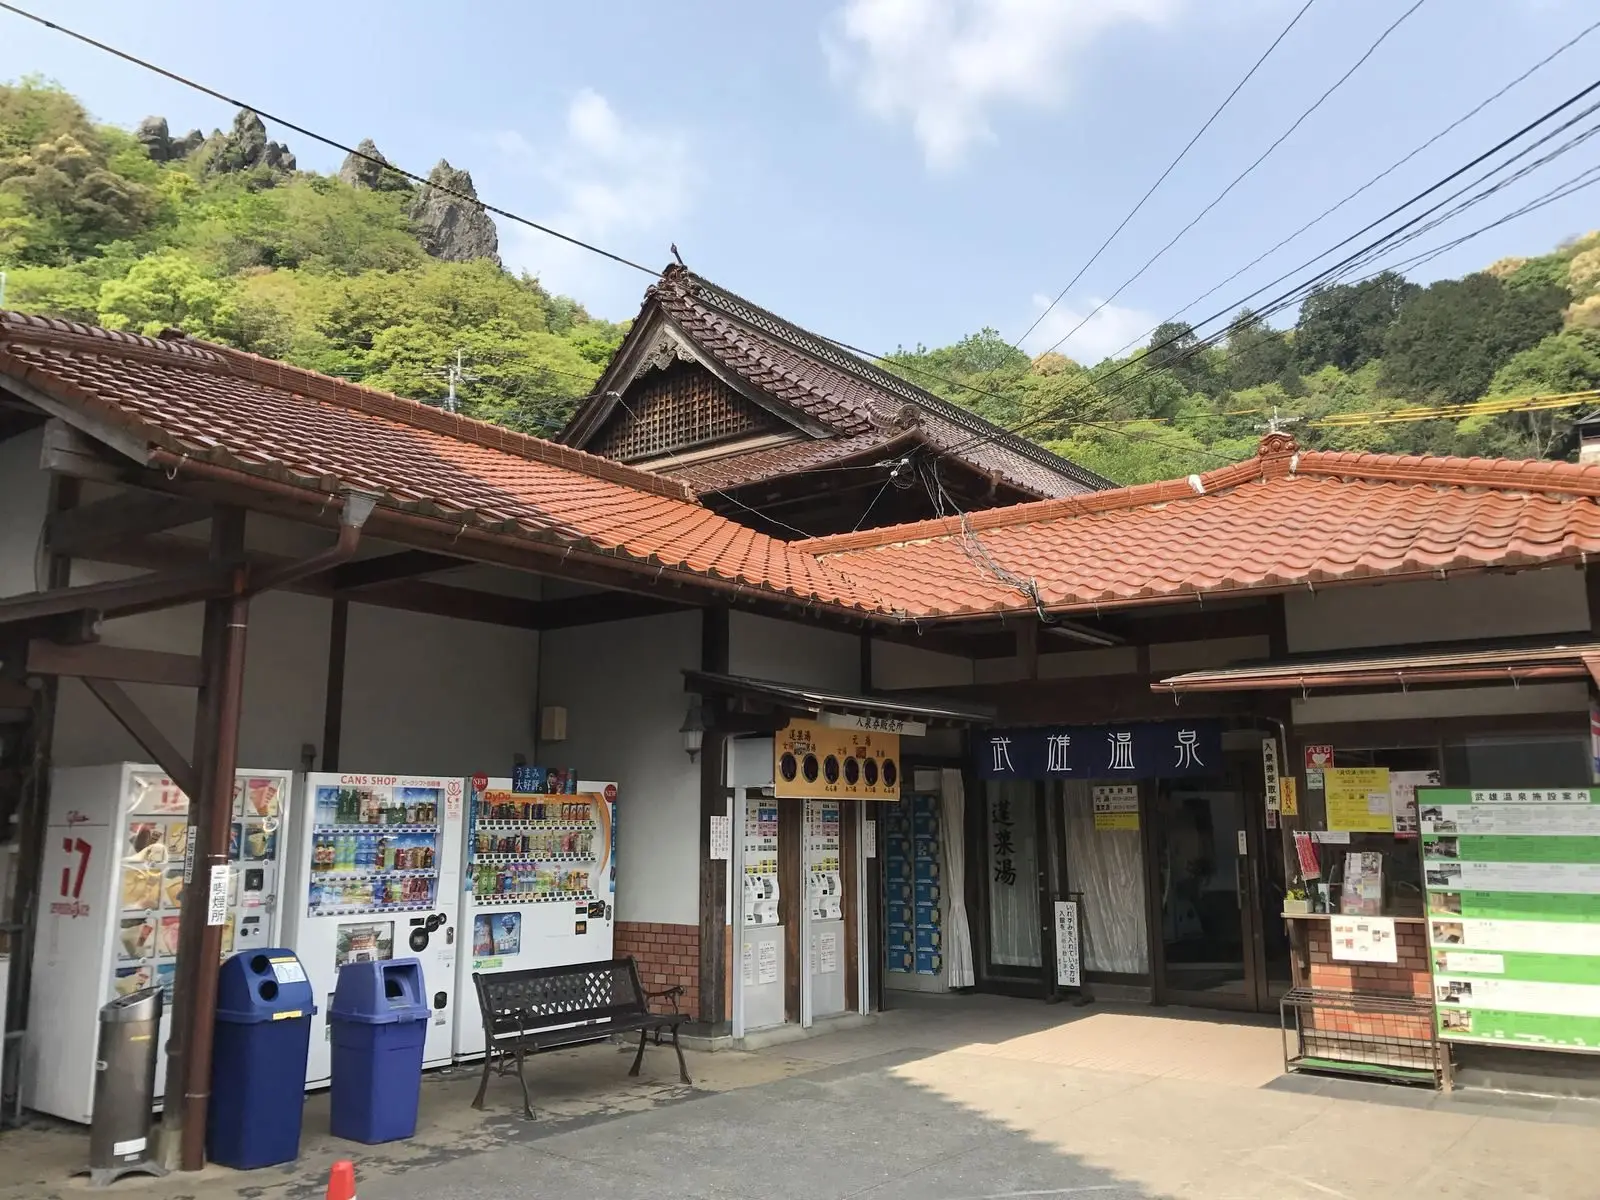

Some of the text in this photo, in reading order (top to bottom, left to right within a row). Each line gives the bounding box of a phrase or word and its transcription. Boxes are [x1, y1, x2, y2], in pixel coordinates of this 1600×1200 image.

[990, 729, 1205, 772] 武雄温泉
[340, 775, 397, 786] CANS SHOP
[1475, 791, 1588, 801] 武雄温泉施設案内
[992, 801, 1017, 886] 蓬莱湯
